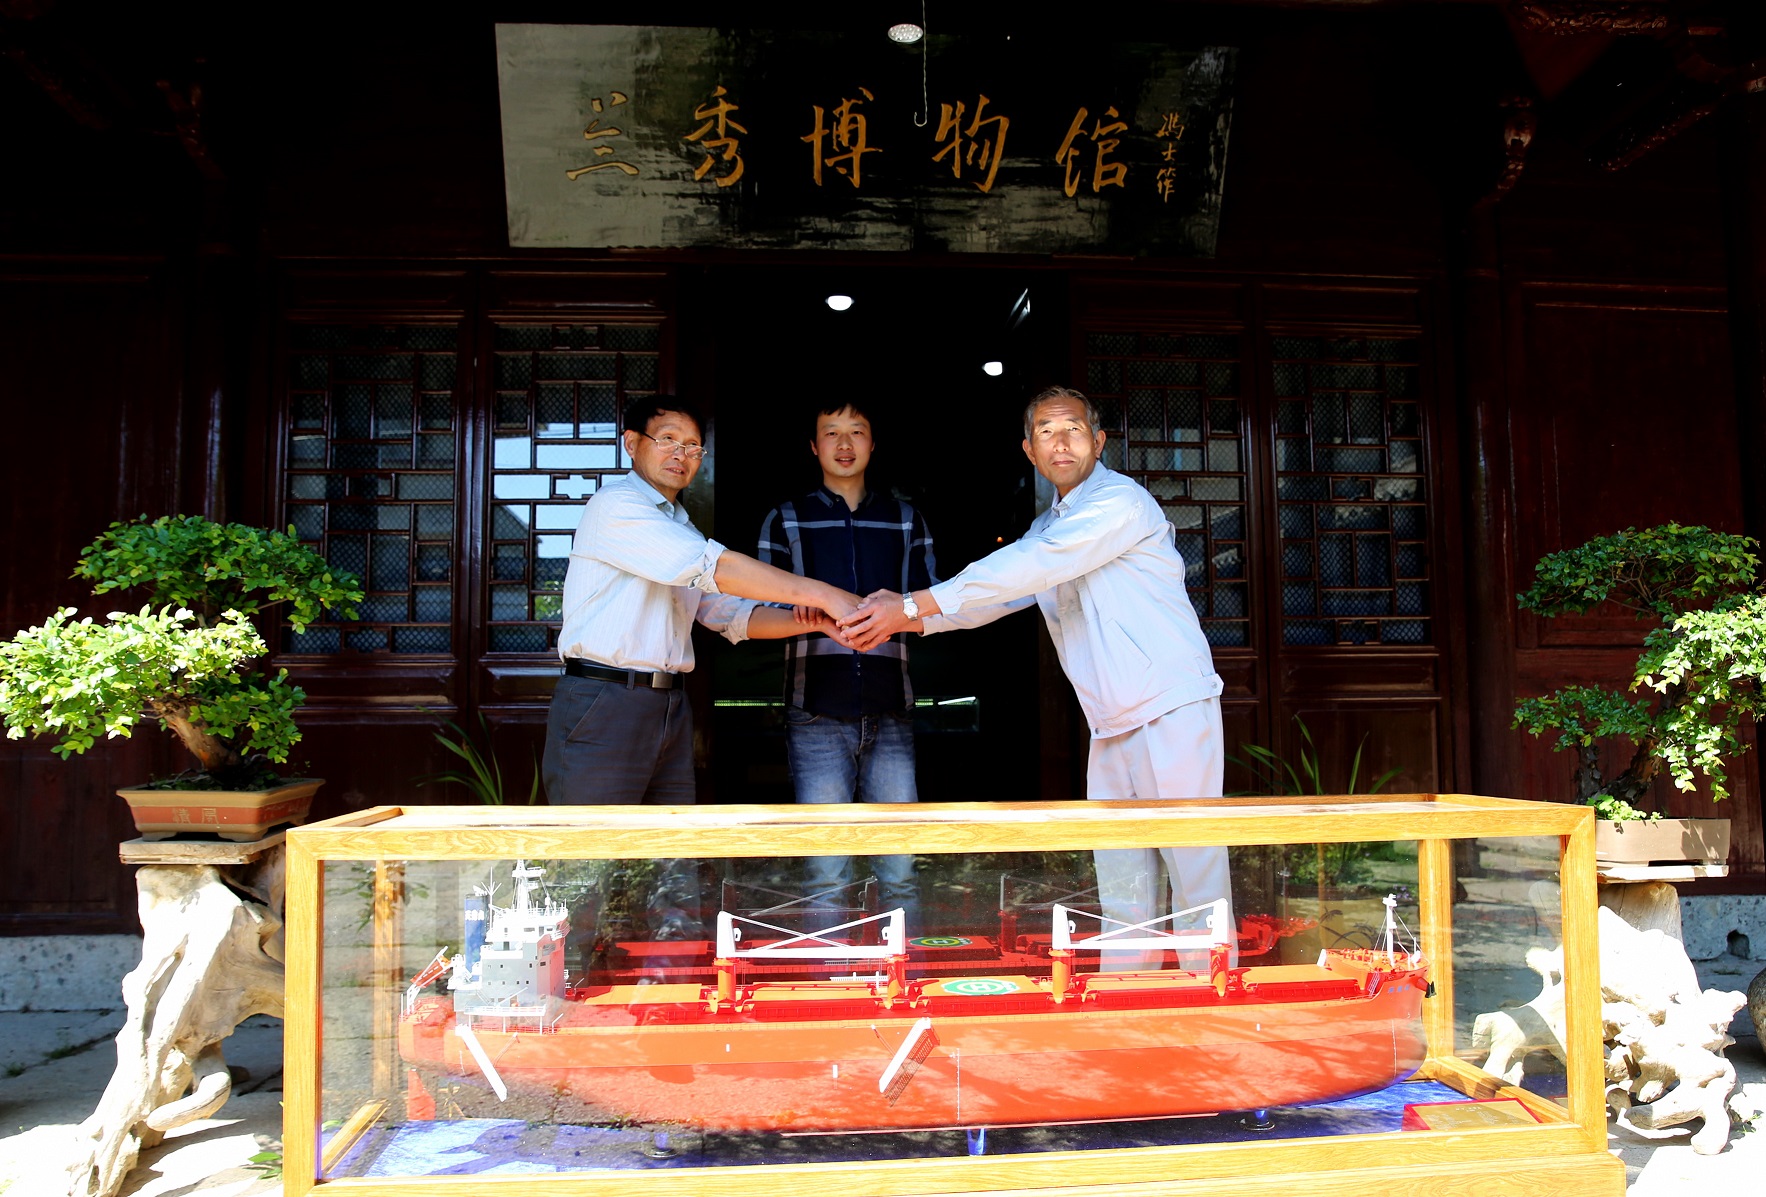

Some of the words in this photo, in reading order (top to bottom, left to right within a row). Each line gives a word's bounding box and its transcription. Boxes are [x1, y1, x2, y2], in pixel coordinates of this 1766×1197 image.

[565, 86, 1128, 198] 兰秀博物馆
